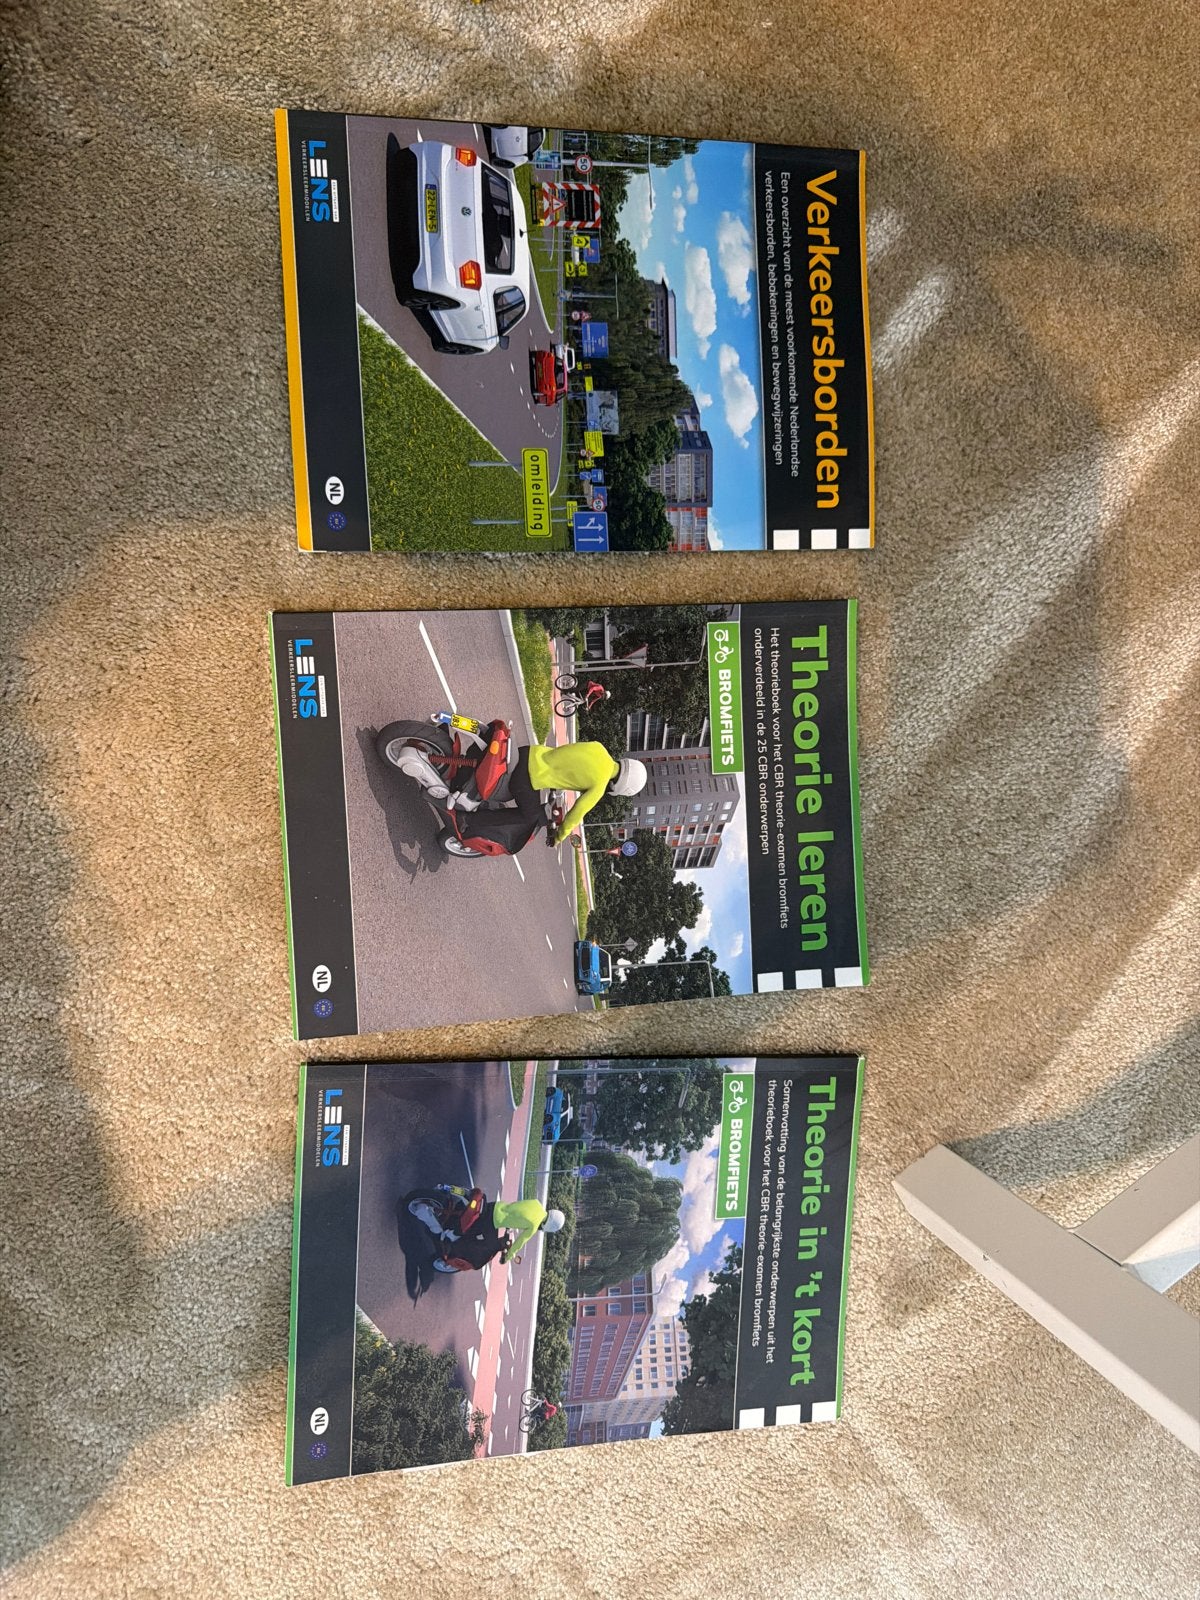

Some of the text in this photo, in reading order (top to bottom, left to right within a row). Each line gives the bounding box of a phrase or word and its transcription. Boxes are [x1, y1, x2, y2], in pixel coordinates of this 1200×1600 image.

[301, 140, 310, 222] VERKEERSLEERMIDDELEN
[308, 141, 330, 222] LENS
[580, 158, 588, 170] 50
[427, 191, 436, 230] 22-LEN-5
[764, 170, 784, 466] verkeersborden, bebakeningen en bewegwijzeringen
[780, 172, 800, 477] Een overzicht van de meest voorkomende Nederlandse
[806, 170, 848, 509] Verkeersborden
[329, 482, 341, 500] NL
[530, 454, 544, 530] omleiding
[595, 500, 602, 510] 50
[288, 640, 298, 718] VERKEERSLEERMIDDELEN
[295, 639, 318, 718] LENS
[718, 669, 734, 766] BROMFIETS
[755, 628, 770, 854] onderverdeeld in de 25 CBR onderwerpen
[770, 628, 789, 928] Het theorieboek voor het CBR theorie-examen bromfiets
[791, 626, 834, 951] Theorie leren
[317, 971, 328, 988] NL
[315, 1090, 324, 1167] VERKEERSLEERMIDDELEN
[322, 1089, 342, 1166] LENS
[777, 1080, 792, 1152] Samenvatting
[800, 1076, 836, 1215] Theorie
[726, 1118, 744, 1211] BROMFIETS
[777, 1177, 786, 1190] de
[752, 1080, 777, 1347] theorieboek voor het CBR theorie-examen bromfiets
[771, 1193, 785, 1258] belangrijkste
[798, 1227, 827, 1260] in
[767, 1260, 779, 1328] onderwerpen
[766, 1347, 775, 1363] het
[767, 1332, 776, 1344] uit
[790, 1308, 820, 1386] kort
[315, 1413, 325, 1431] NL
